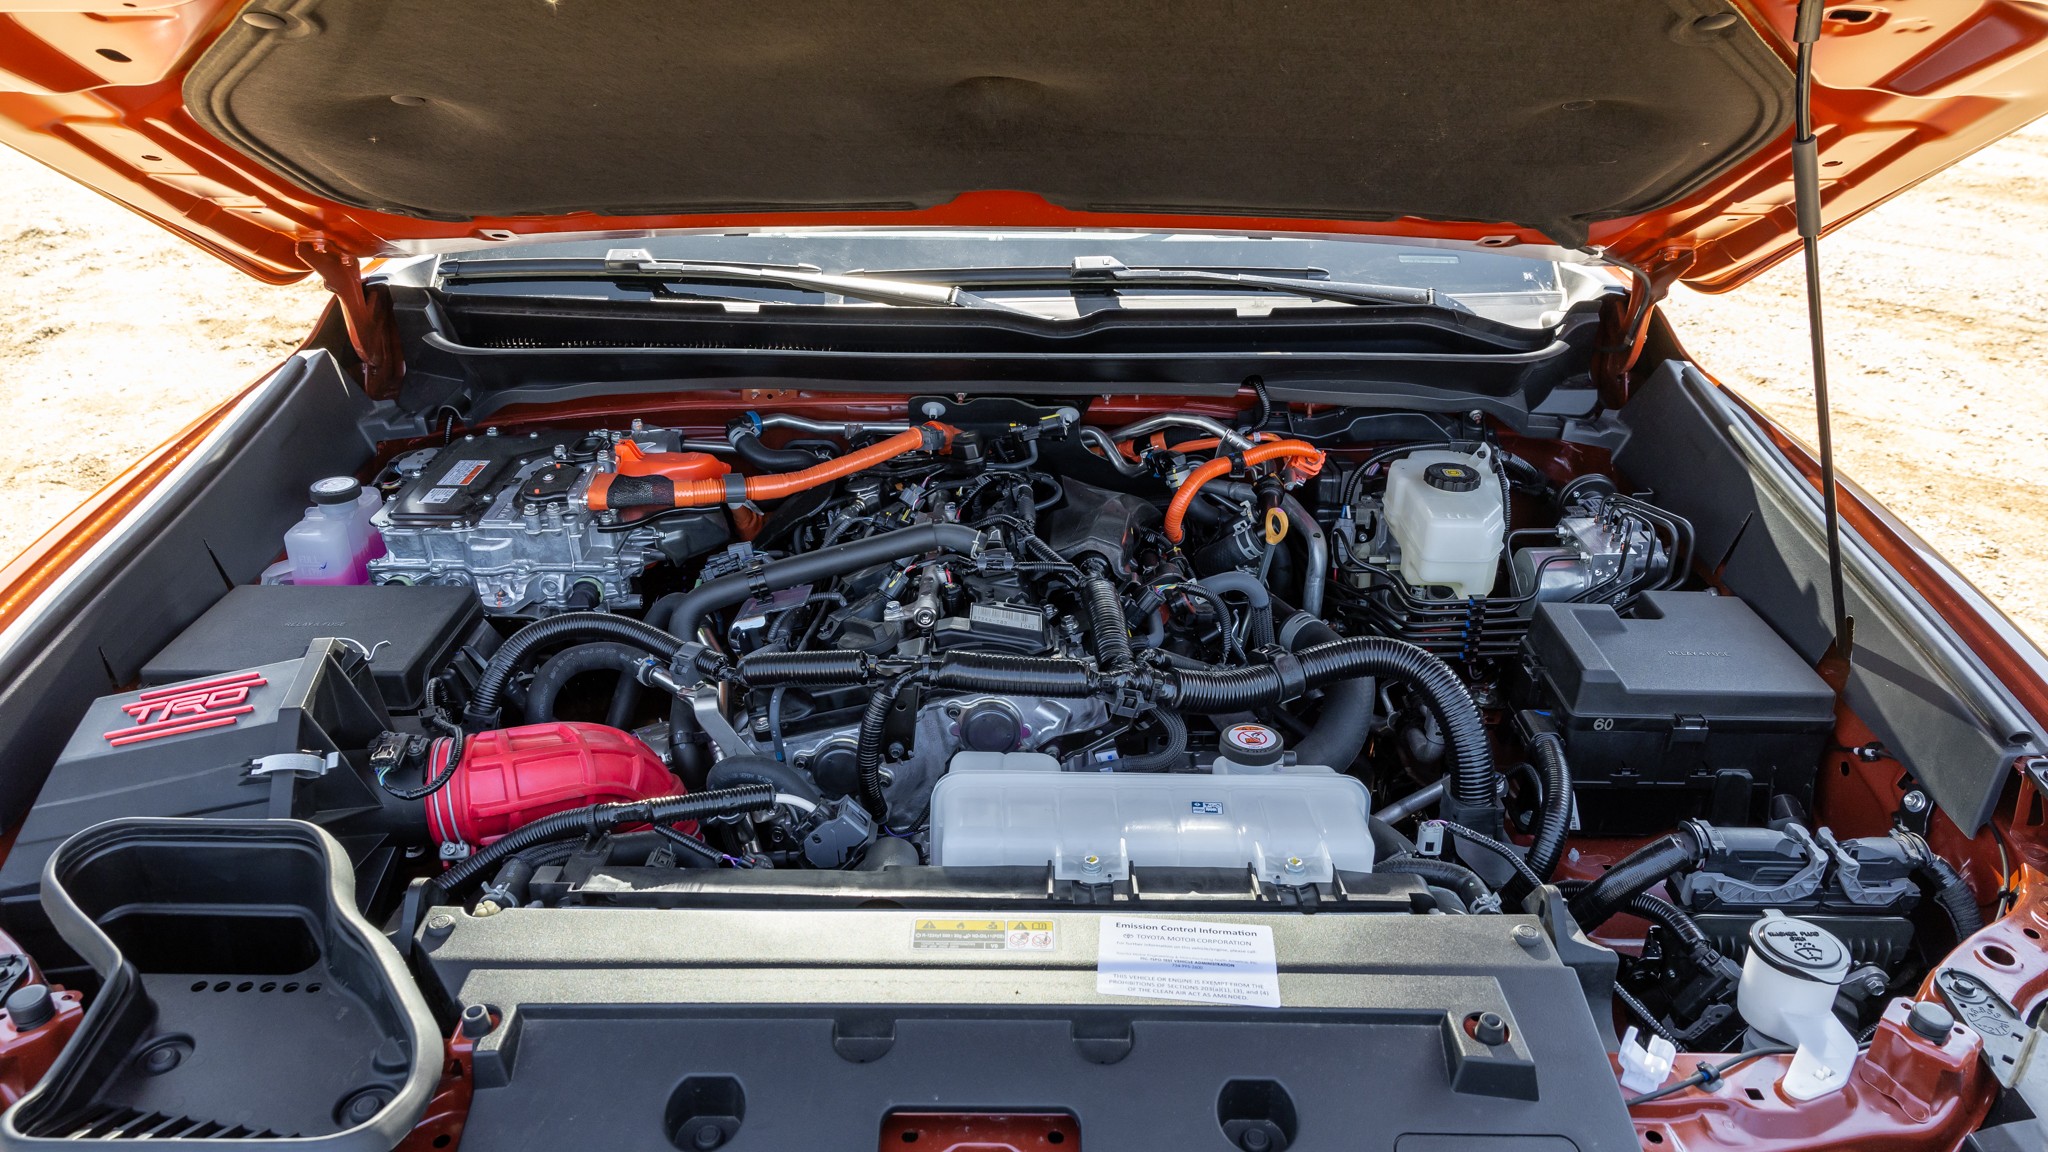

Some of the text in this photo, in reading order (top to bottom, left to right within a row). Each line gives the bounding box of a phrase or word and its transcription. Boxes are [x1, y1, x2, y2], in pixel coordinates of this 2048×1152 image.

[128, 686, 249, 724] TRD
[1594, 718, 1614, 730] 60
[1116, 922, 1258, 937] Emission Control Information
[1196, 938, 1252, 946] CORPORATION
